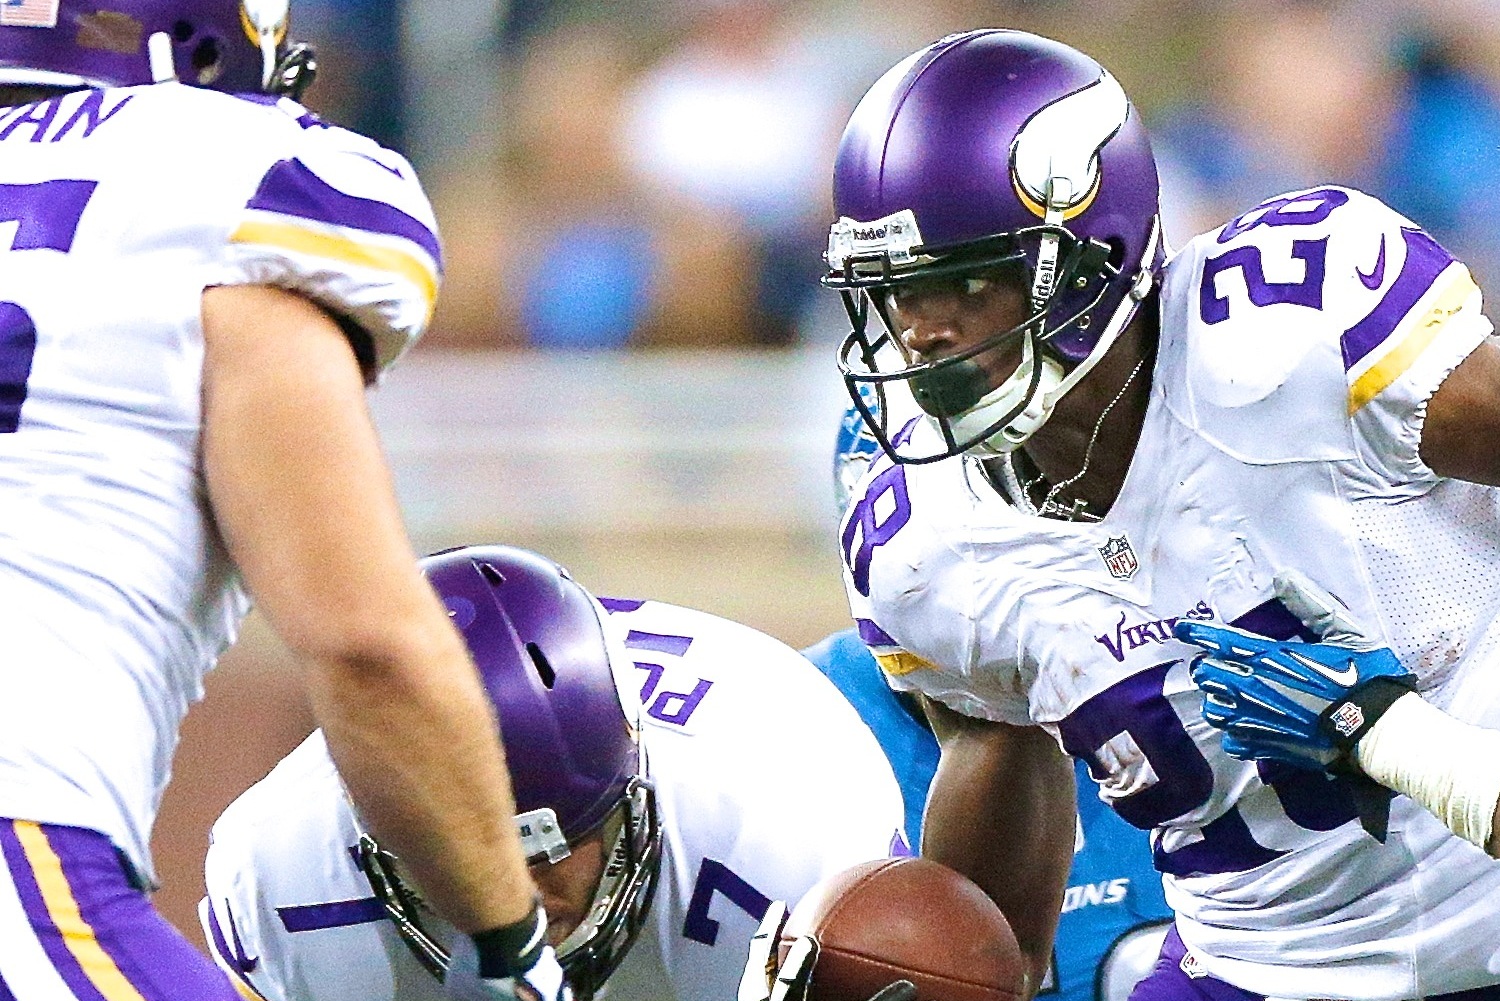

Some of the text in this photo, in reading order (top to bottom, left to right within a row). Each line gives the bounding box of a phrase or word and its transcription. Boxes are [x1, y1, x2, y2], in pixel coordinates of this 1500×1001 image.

[1200, 189, 1349, 325] 28
[1108, 551, 1136, 575] NFL
[682, 856, 788, 947] 7
